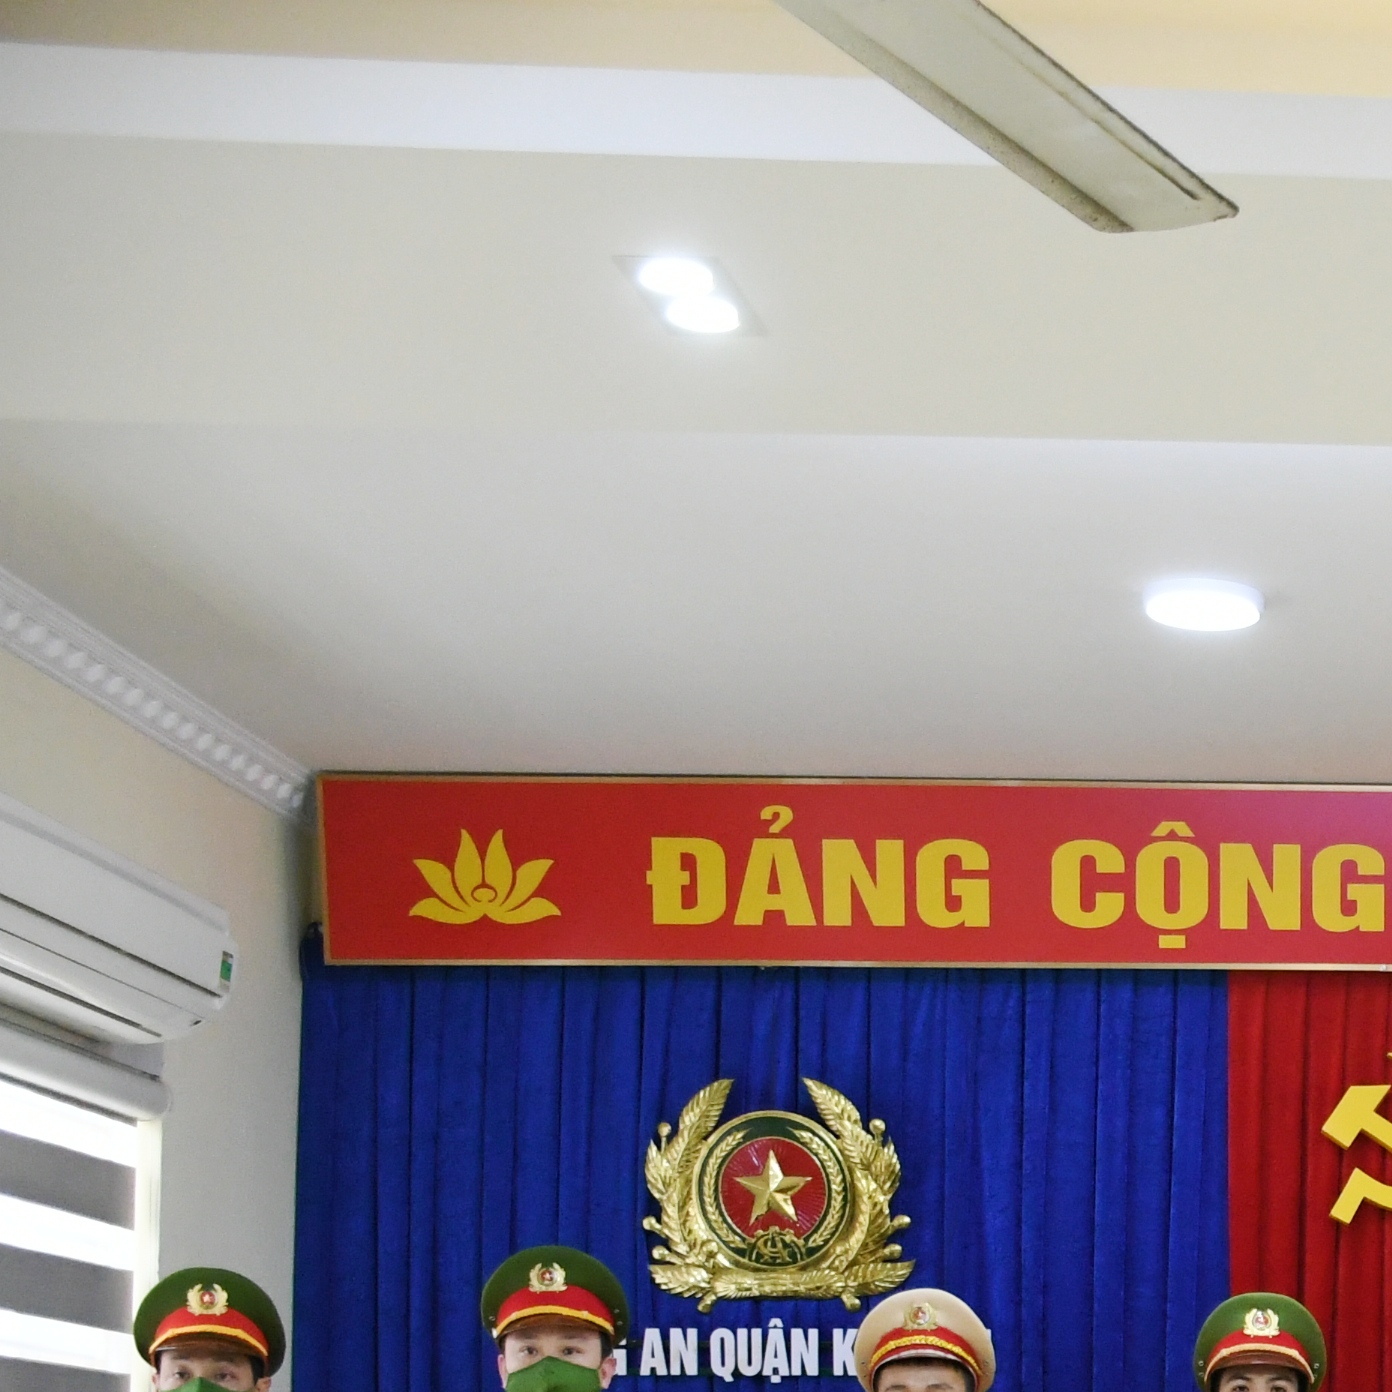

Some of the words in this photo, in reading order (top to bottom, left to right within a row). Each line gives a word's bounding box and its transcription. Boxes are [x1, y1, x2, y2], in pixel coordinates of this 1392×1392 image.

[646, 806, 991, 928] ĐẢNG
[1051, 820, 1385, 949] CỘNG
[639, 1327, 699, 1377] AN
[708, 1317, 819, 1384] QUẬN
